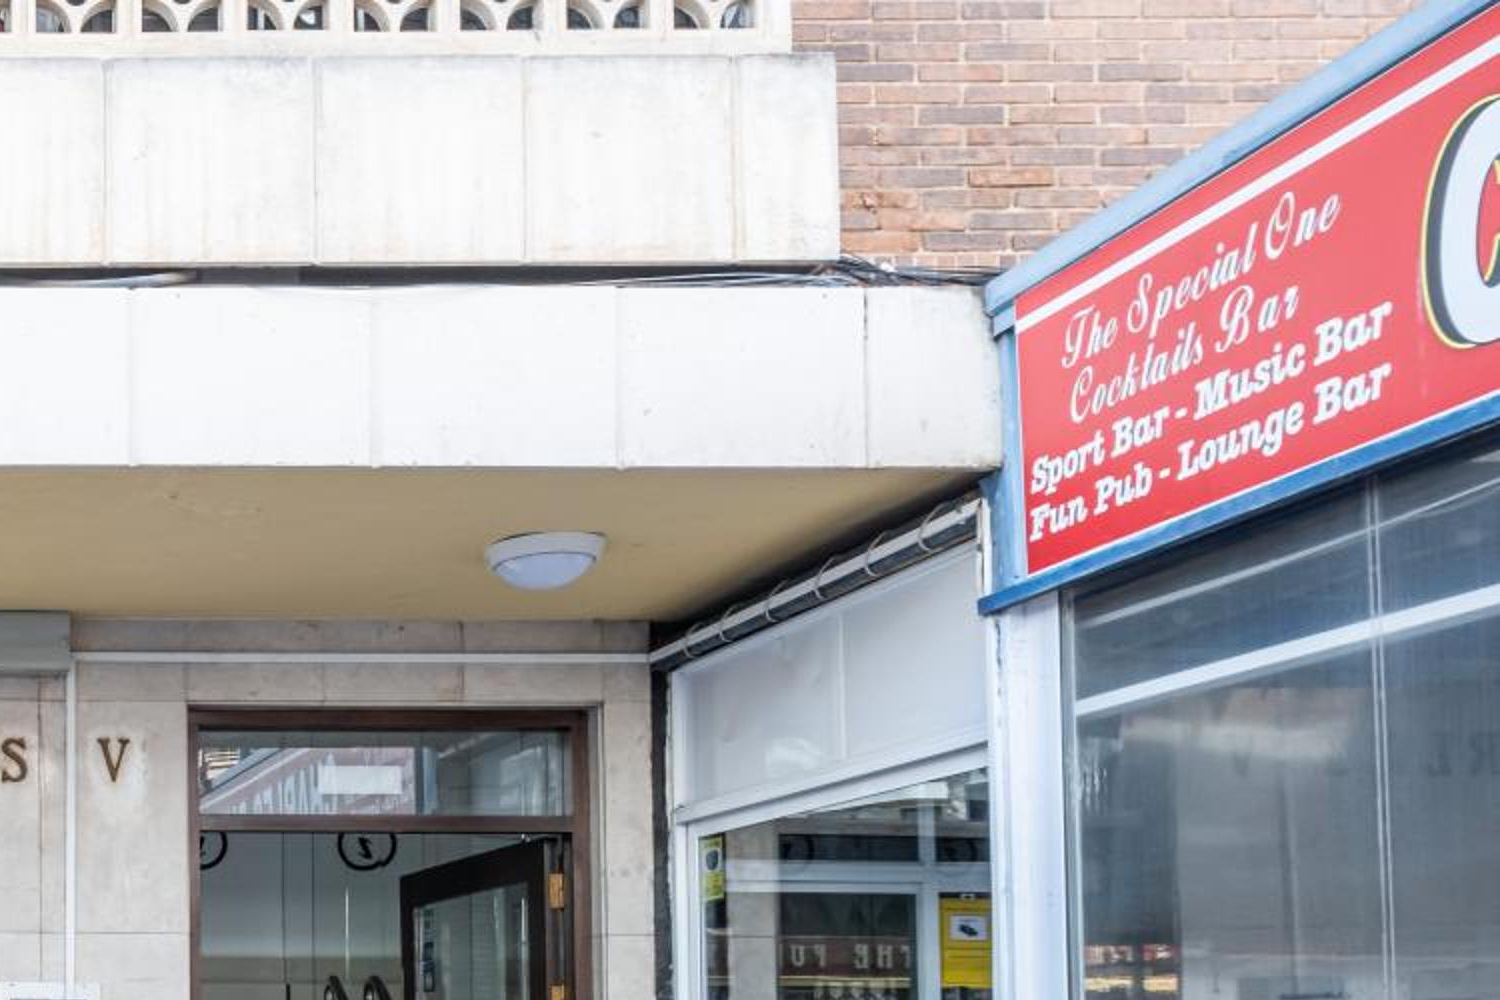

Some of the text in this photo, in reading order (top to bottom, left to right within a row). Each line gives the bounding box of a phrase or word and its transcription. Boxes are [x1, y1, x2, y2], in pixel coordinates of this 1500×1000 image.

[1061, 191, 1340, 368] The Special One
[1069, 285, 1300, 423] Cocktails Bar
[1029, 495, 1088, 543] Fun
[1093, 462, 1153, 514] Pub
[1176, 401, 1305, 481] Lounge
[1312, 362, 1392, 425] Bar
[1030, 436, 1105, 495] Sport
[1111, 406, 1170, 458] Bar
[1193, 342, 1306, 420] Music
[1313, 301, 1393, 366] Bar
[97, 736, 131, 784] V
